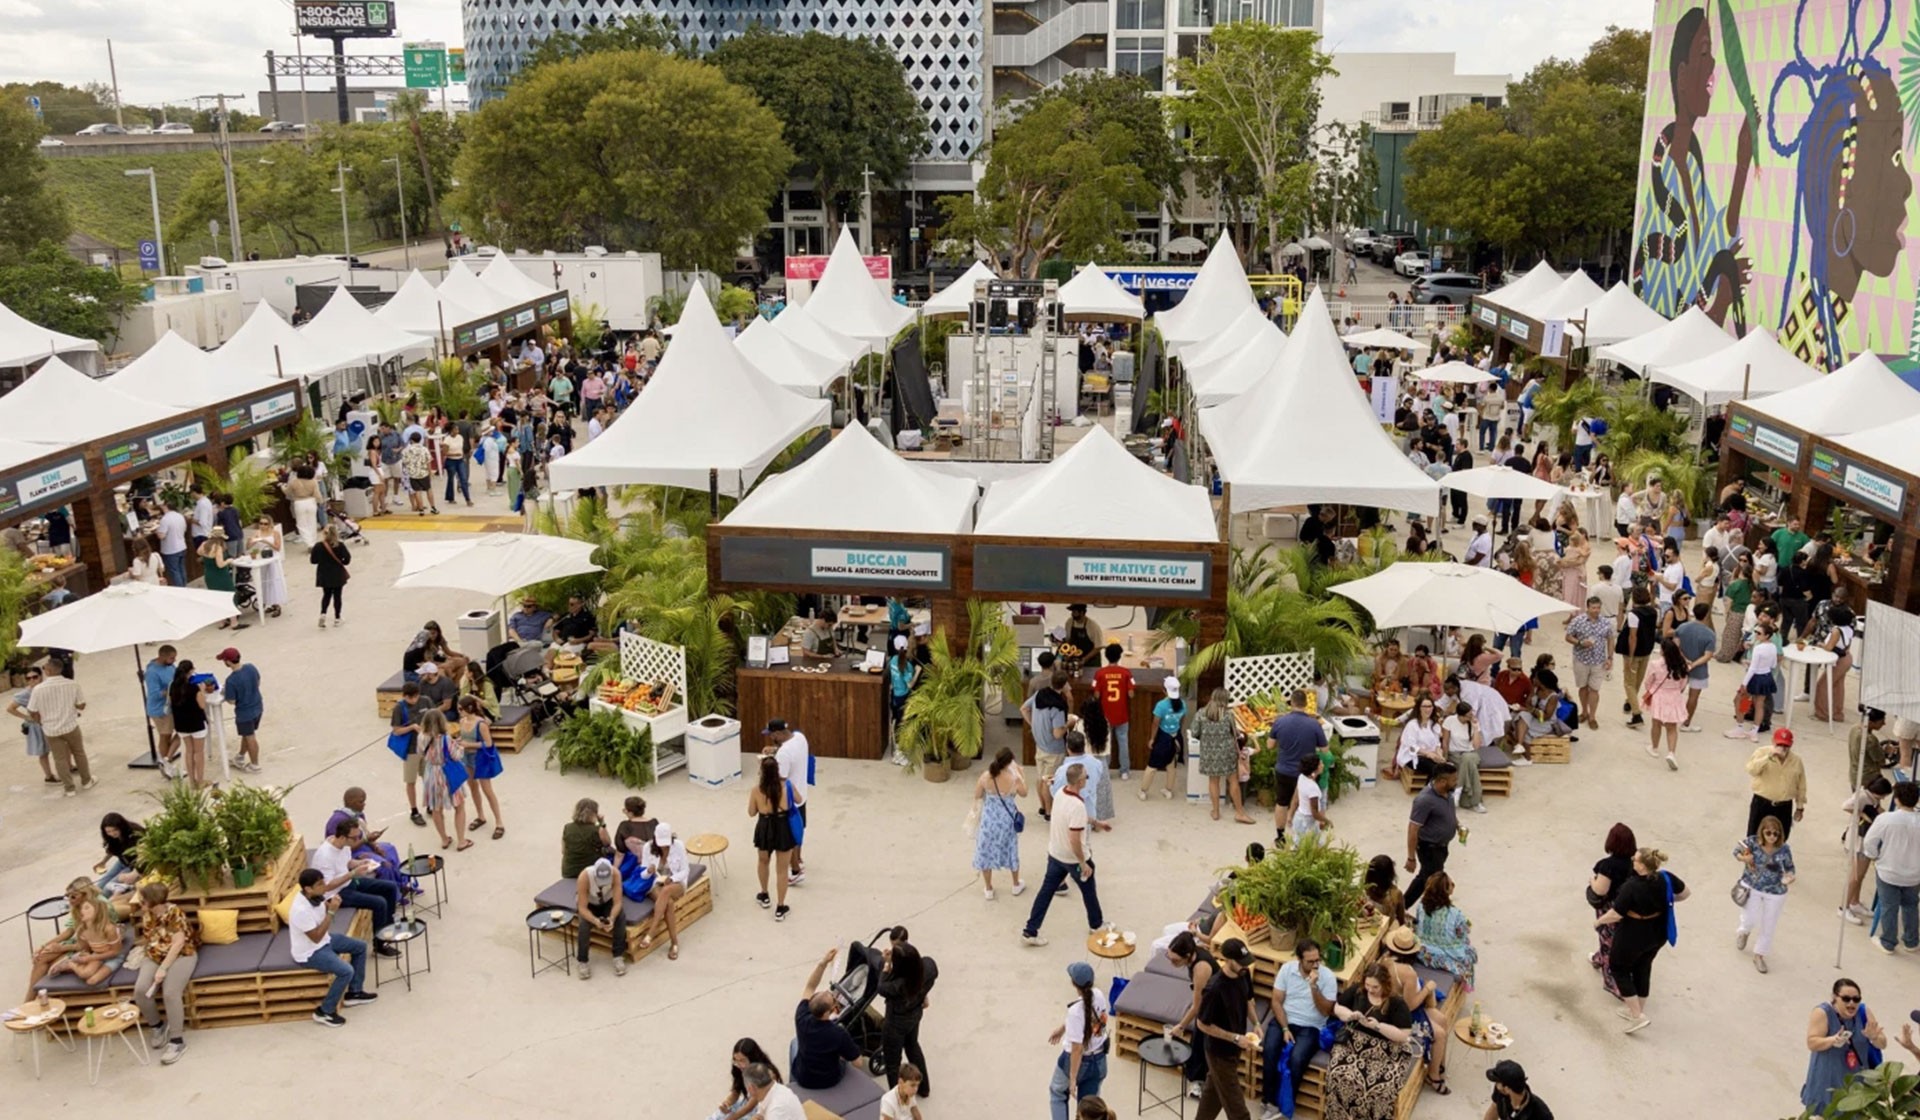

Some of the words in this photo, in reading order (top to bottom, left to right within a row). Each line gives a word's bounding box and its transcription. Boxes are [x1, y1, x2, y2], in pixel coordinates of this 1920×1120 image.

[297, 7, 364, 17] 1-800-CAR
[299, 17, 366, 26] INSURANCE
[41, 470, 61, 485] ESME
[847, 553, 907, 567] BUCCAN
[896, 569, 938, 577] CROQUETTE
[1083, 562, 1106, 573] THE
[1110, 563, 1156, 575] NATIVE
[1159, 565, 1188, 576] GUY
[1107, 680, 1120, 701] 5
